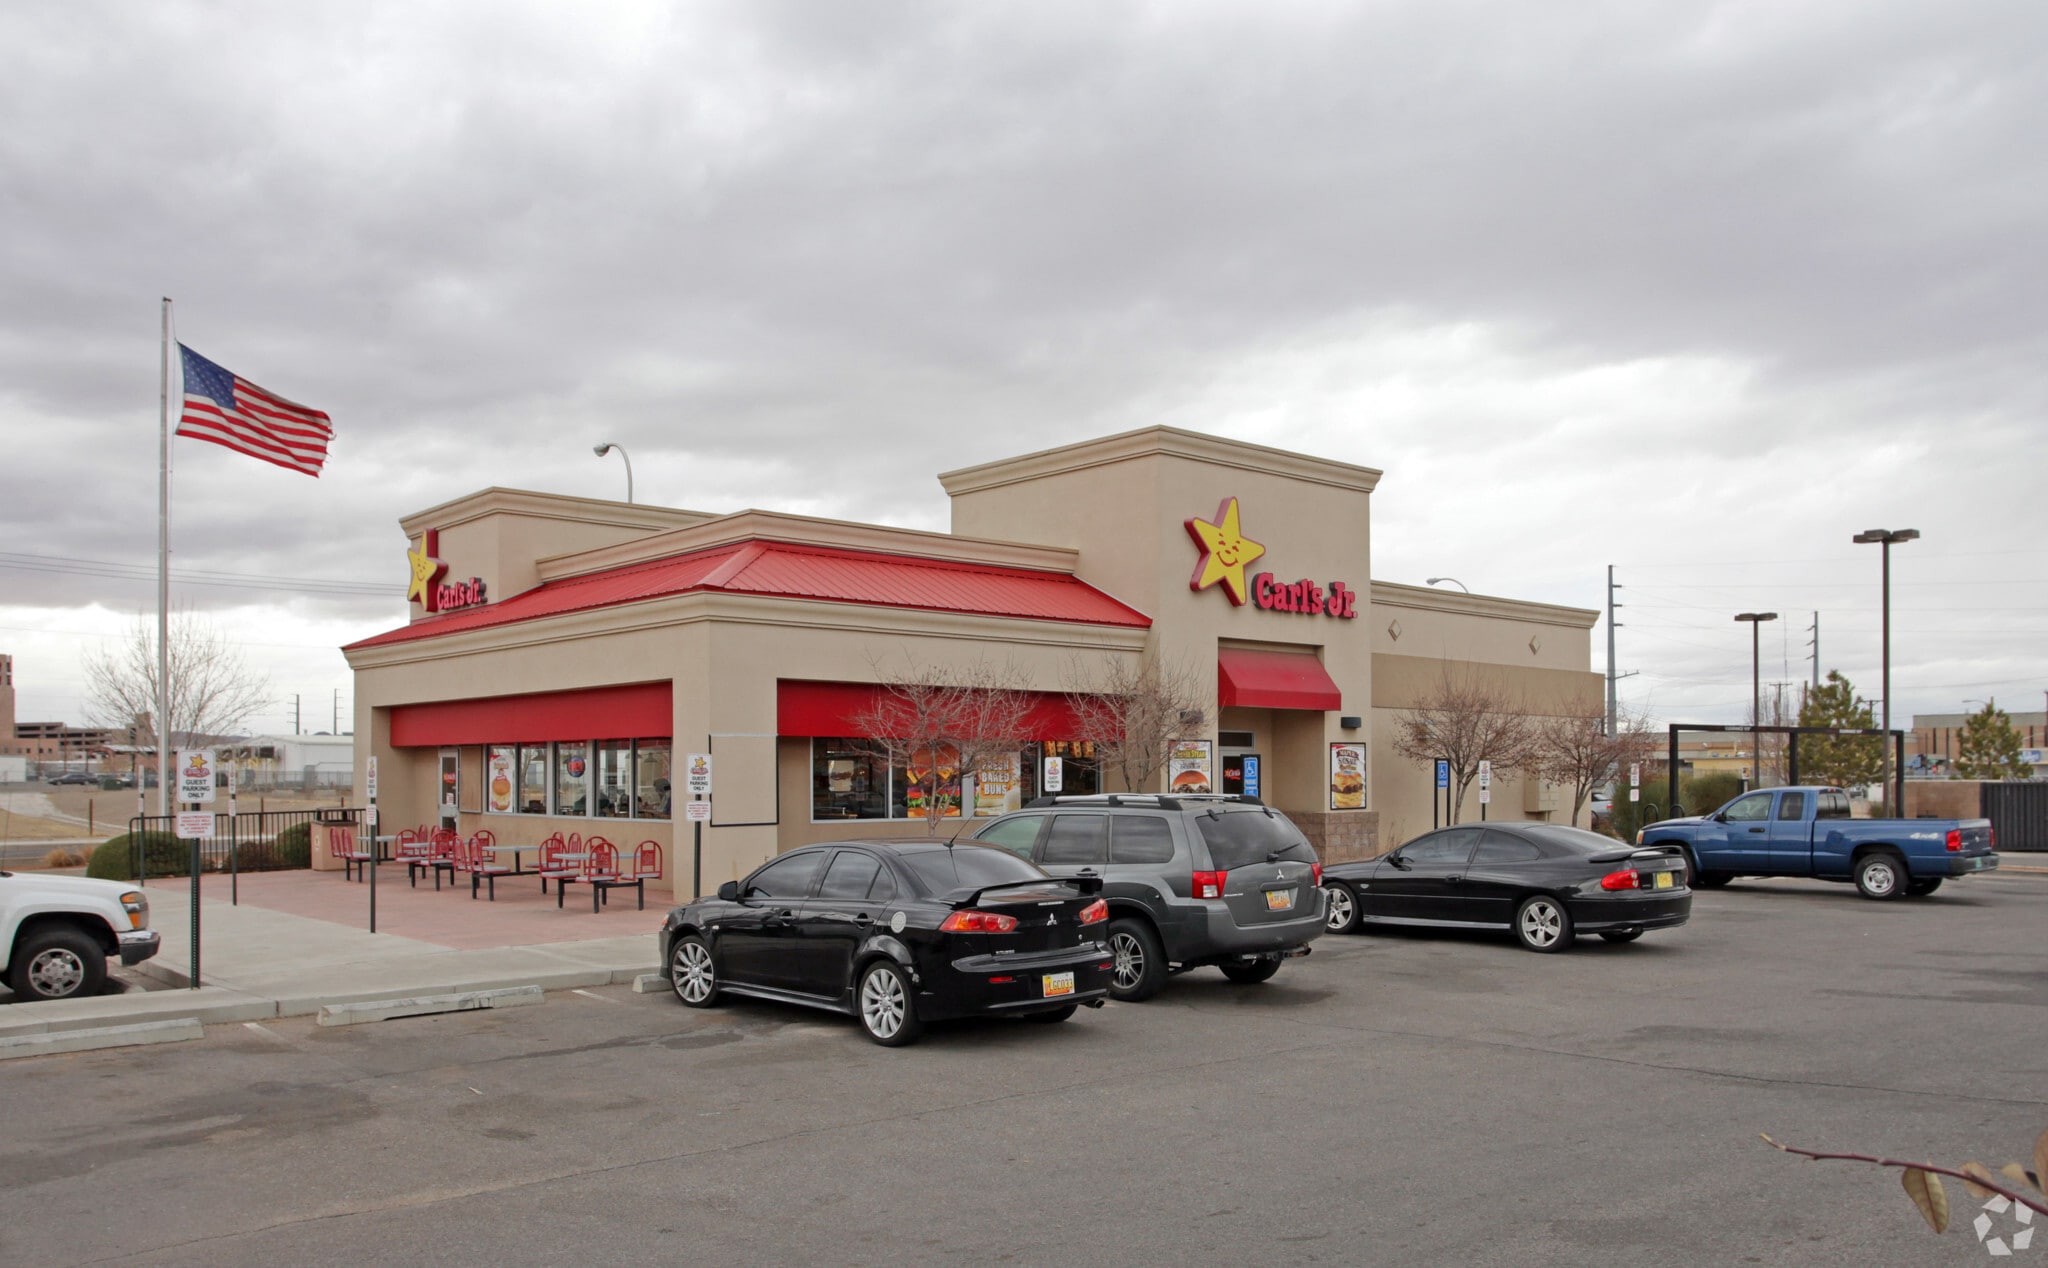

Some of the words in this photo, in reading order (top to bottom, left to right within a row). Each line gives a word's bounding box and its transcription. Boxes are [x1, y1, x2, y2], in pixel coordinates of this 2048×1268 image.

[437, 582, 467, 610] Carl's
[1253, 572, 1324, 614] Carl's
[1325, 581, 1358, 617] Jr.
[981, 772, 1010, 783] BAKED
[984, 784, 1007, 795] BUNS
